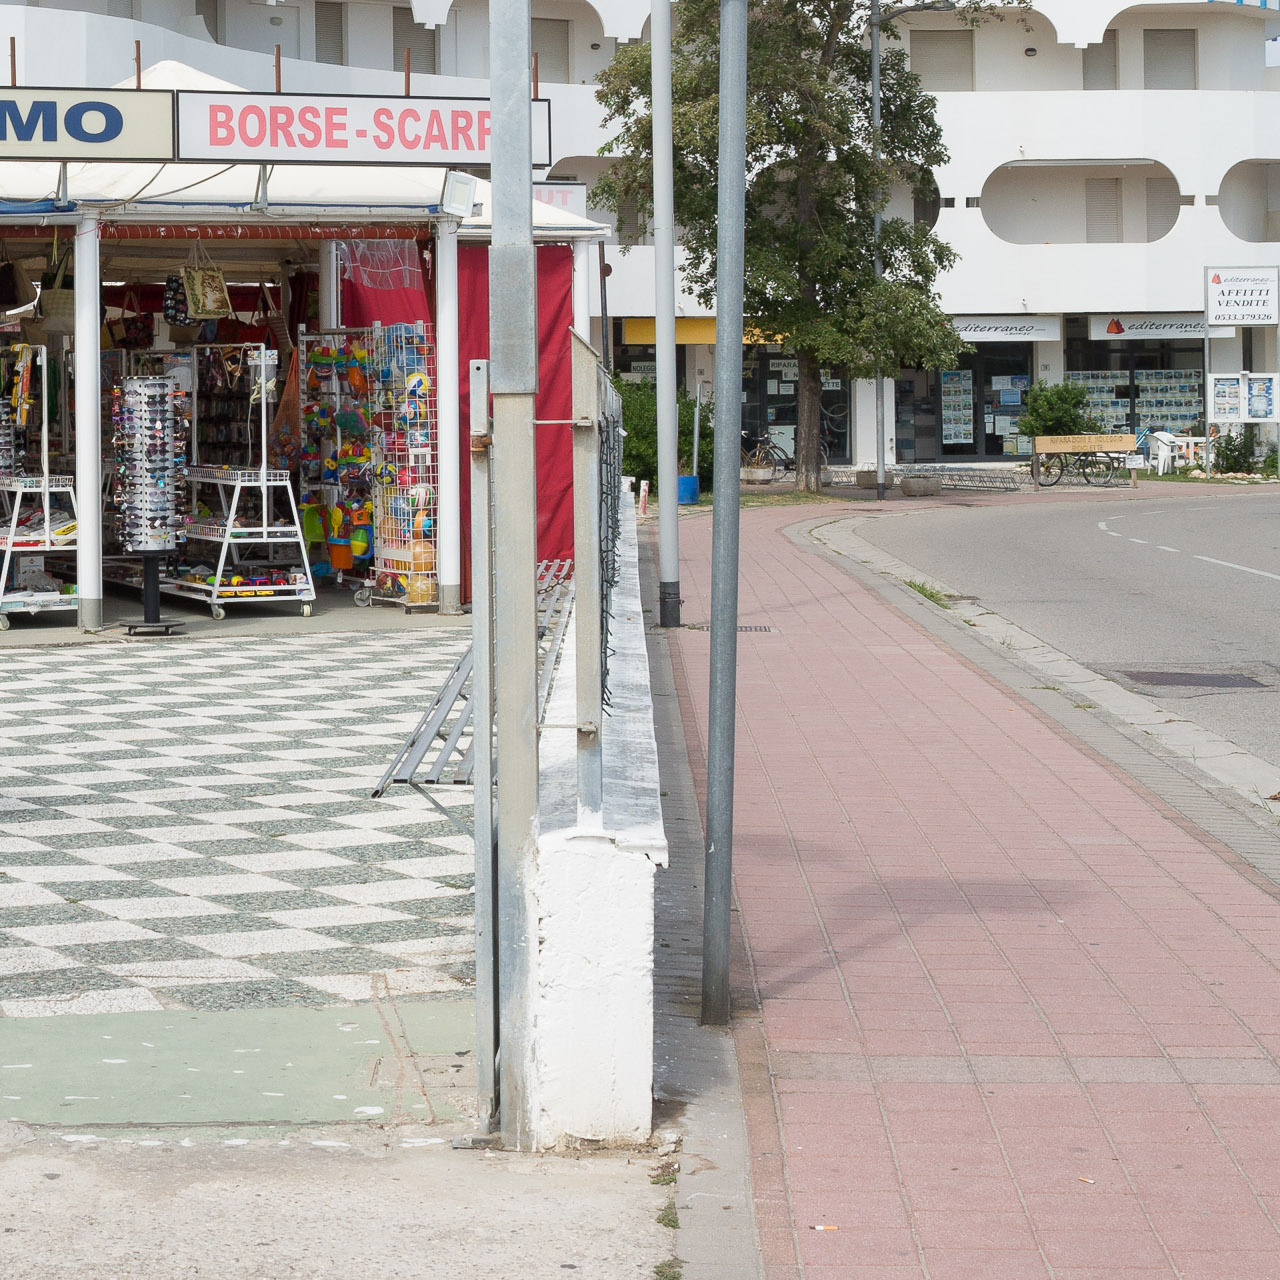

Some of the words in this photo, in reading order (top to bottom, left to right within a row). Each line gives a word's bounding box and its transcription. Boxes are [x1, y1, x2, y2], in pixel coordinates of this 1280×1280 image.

[209, 104, 491, 151] BORSE-SCARP
[1217, 289, 1270, 297] AFFITTI
[1217, 299, 1269, 307] VENDITE
[770, 361, 799, 369] RIPARA
